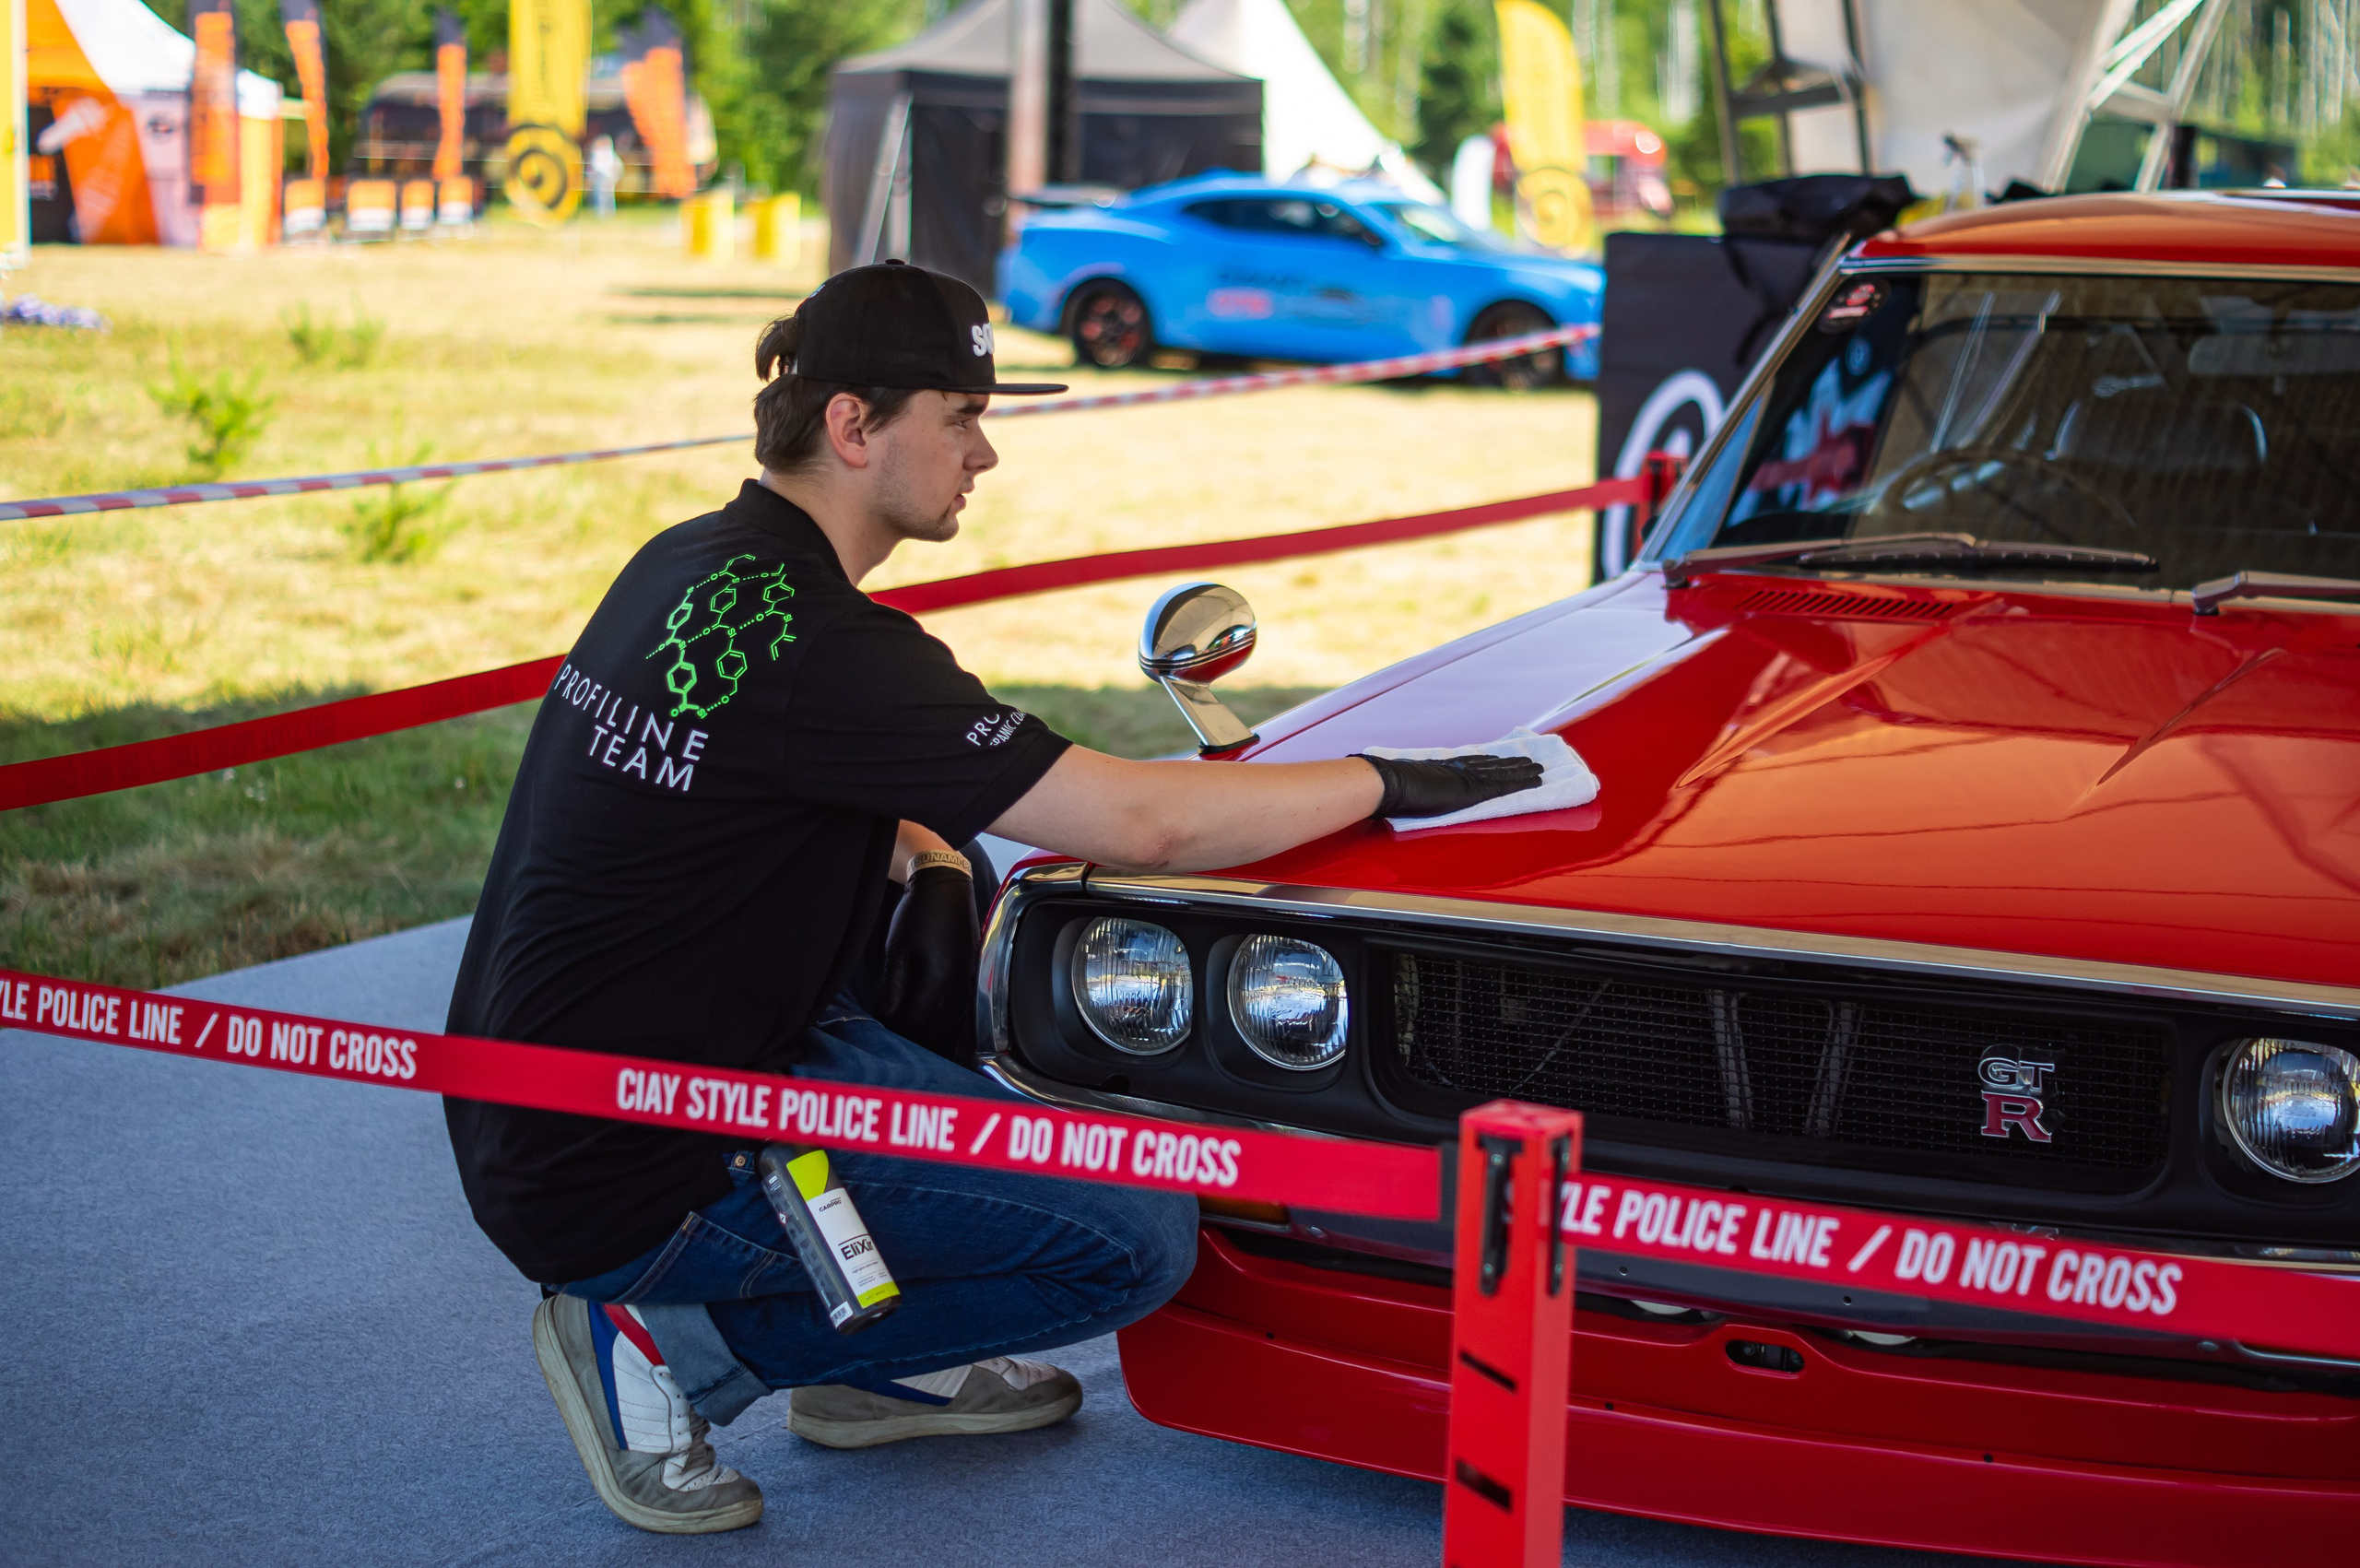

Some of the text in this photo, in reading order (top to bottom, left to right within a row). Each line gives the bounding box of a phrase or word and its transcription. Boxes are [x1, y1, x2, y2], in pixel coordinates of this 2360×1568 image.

[554, 663, 709, 762] PROFILINE
[588, 725, 694, 792] TEAM
[36, 985, 122, 1035] POLICE
[128, 1000, 183, 1044] LINE
[227, 1016, 262, 1057] DO
[270, 1022, 324, 1066] NOT
[328, 1032, 418, 1080] CROSS
[1977, 1057, 2055, 1093] GT
[618, 1067, 681, 1115] CIAY
[686, 1076, 773, 1128] STYLE
[778, 1088, 883, 1143] POLICE
[889, 1102, 959, 1152] LINE
[1008, 1114, 1054, 1164] DO
[1060, 1121, 1129, 1173] NOT
[1131, 1128, 1242, 1187] CROSS
[1980, 1090, 2053, 1143] R
[819, 1198, 843, 1212] CARPRO
[1612, 1189, 1748, 1255] POLICE
[1750, 1208, 1840, 1267] LINE
[1894, 1227, 1955, 1284] DO
[1959, 1237, 2047, 1297] NOT
[2047, 1248, 2183, 1315] CROSS
